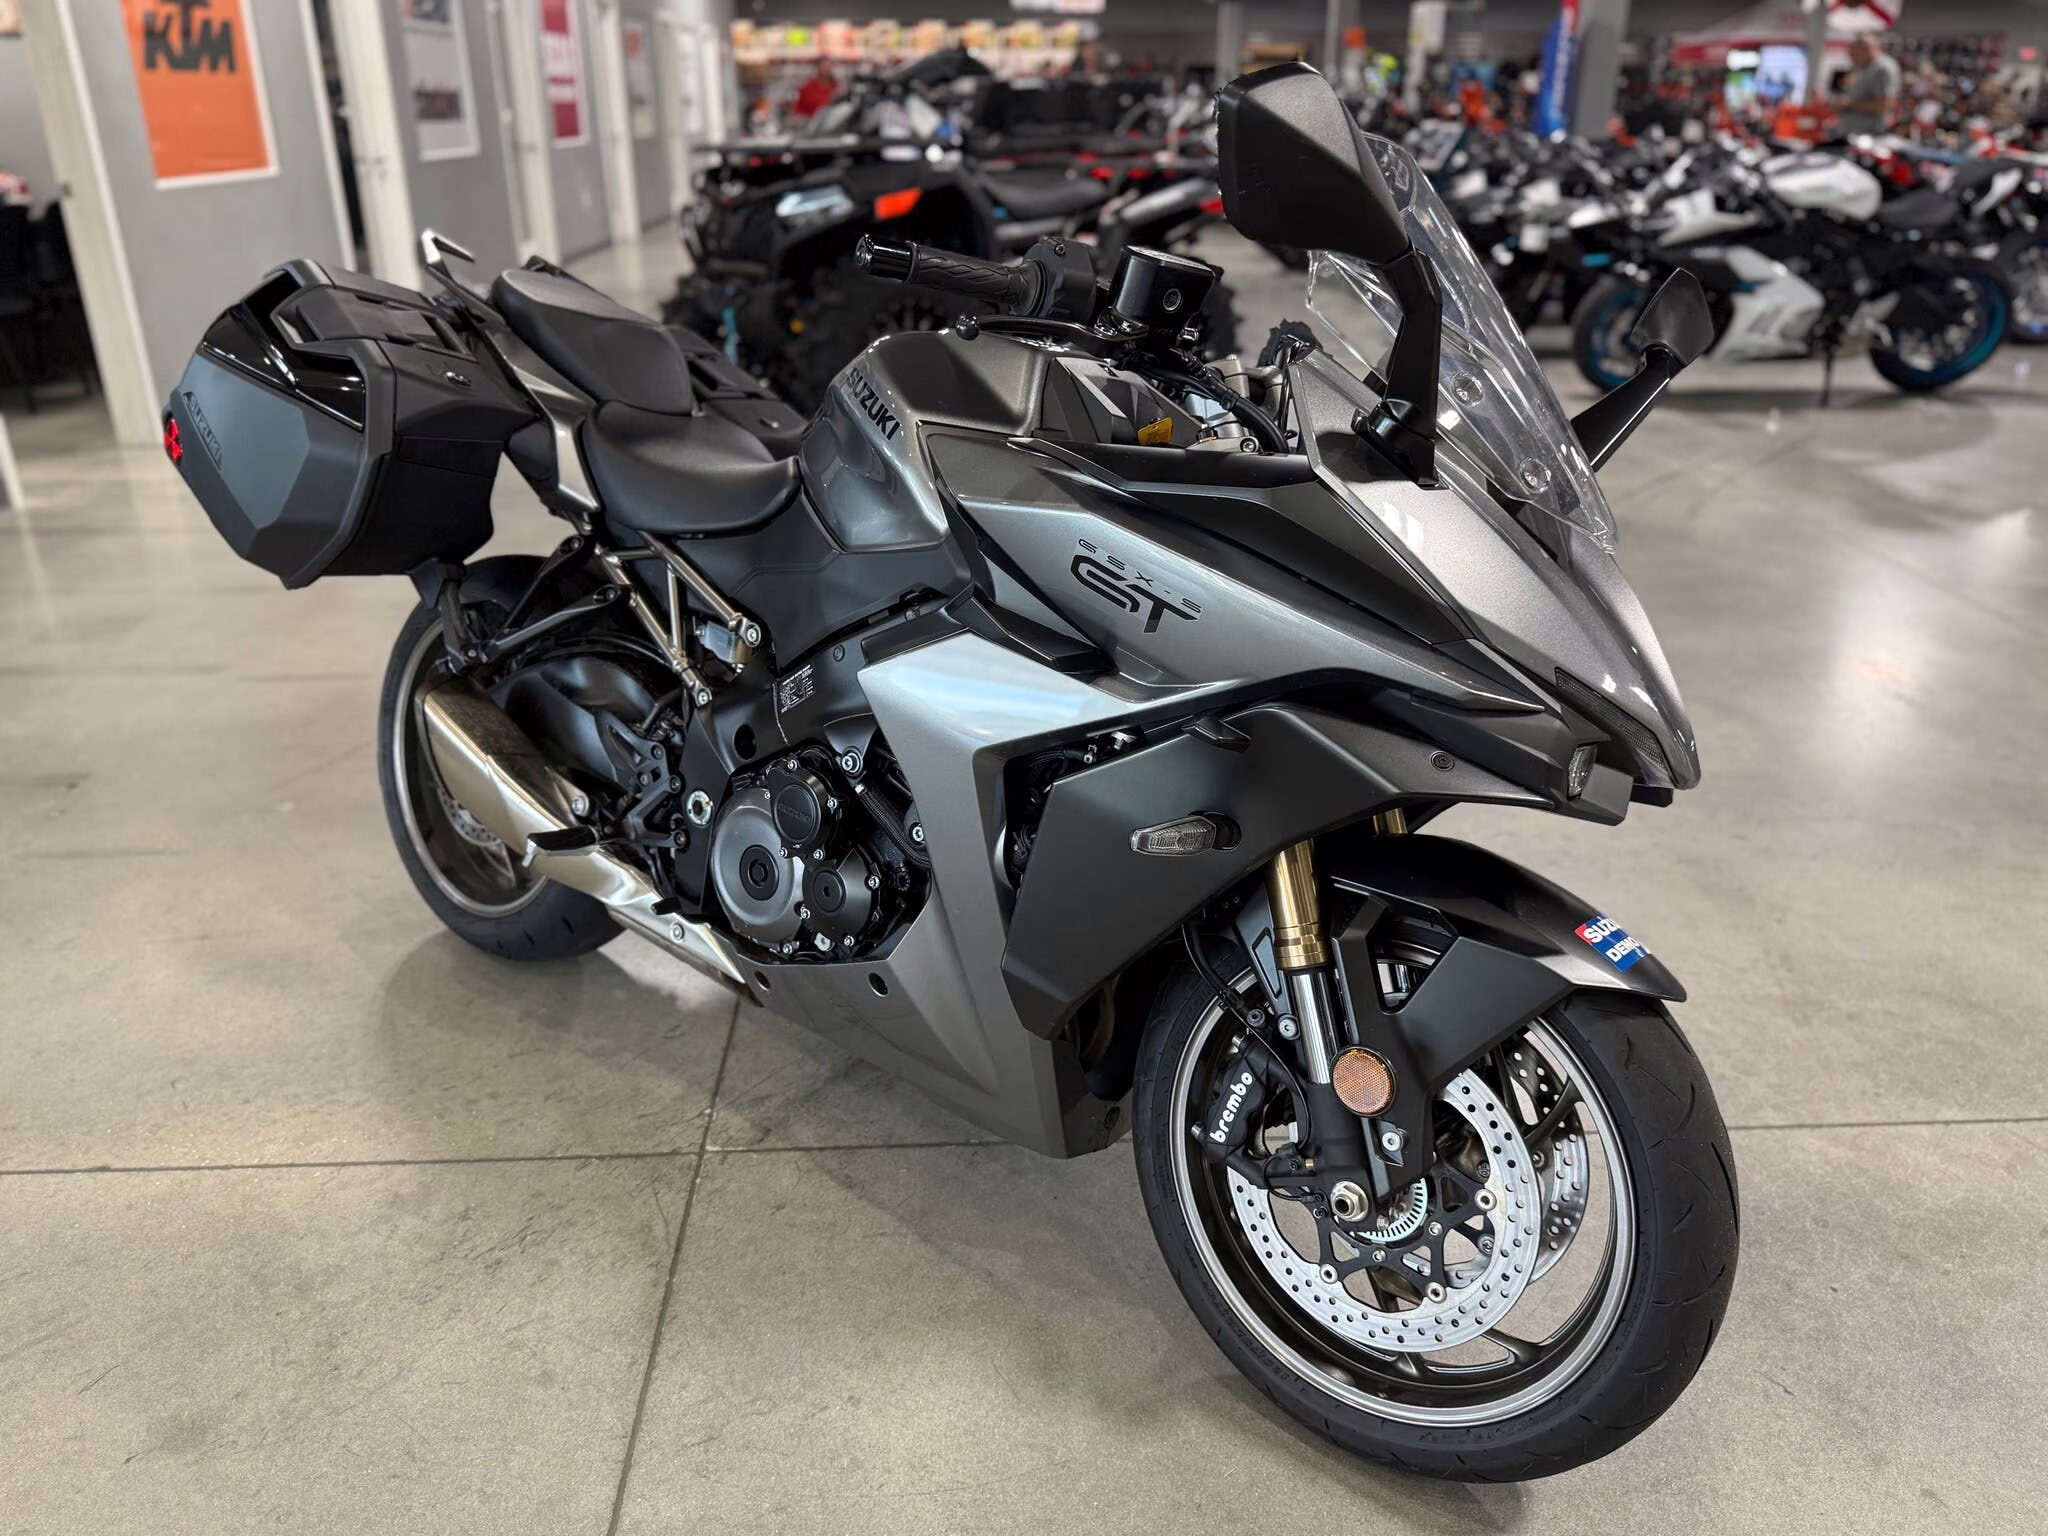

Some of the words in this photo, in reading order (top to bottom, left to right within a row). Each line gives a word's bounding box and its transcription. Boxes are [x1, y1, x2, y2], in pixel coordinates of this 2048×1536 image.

[142, 0, 237, 74] KTM
[184, 394, 223, 469] SUZUKI
[846, 366, 901, 441] SUZUKI
[1605, 936, 1641, 963] DEMO
[1209, 1072, 1253, 1143] brembo
